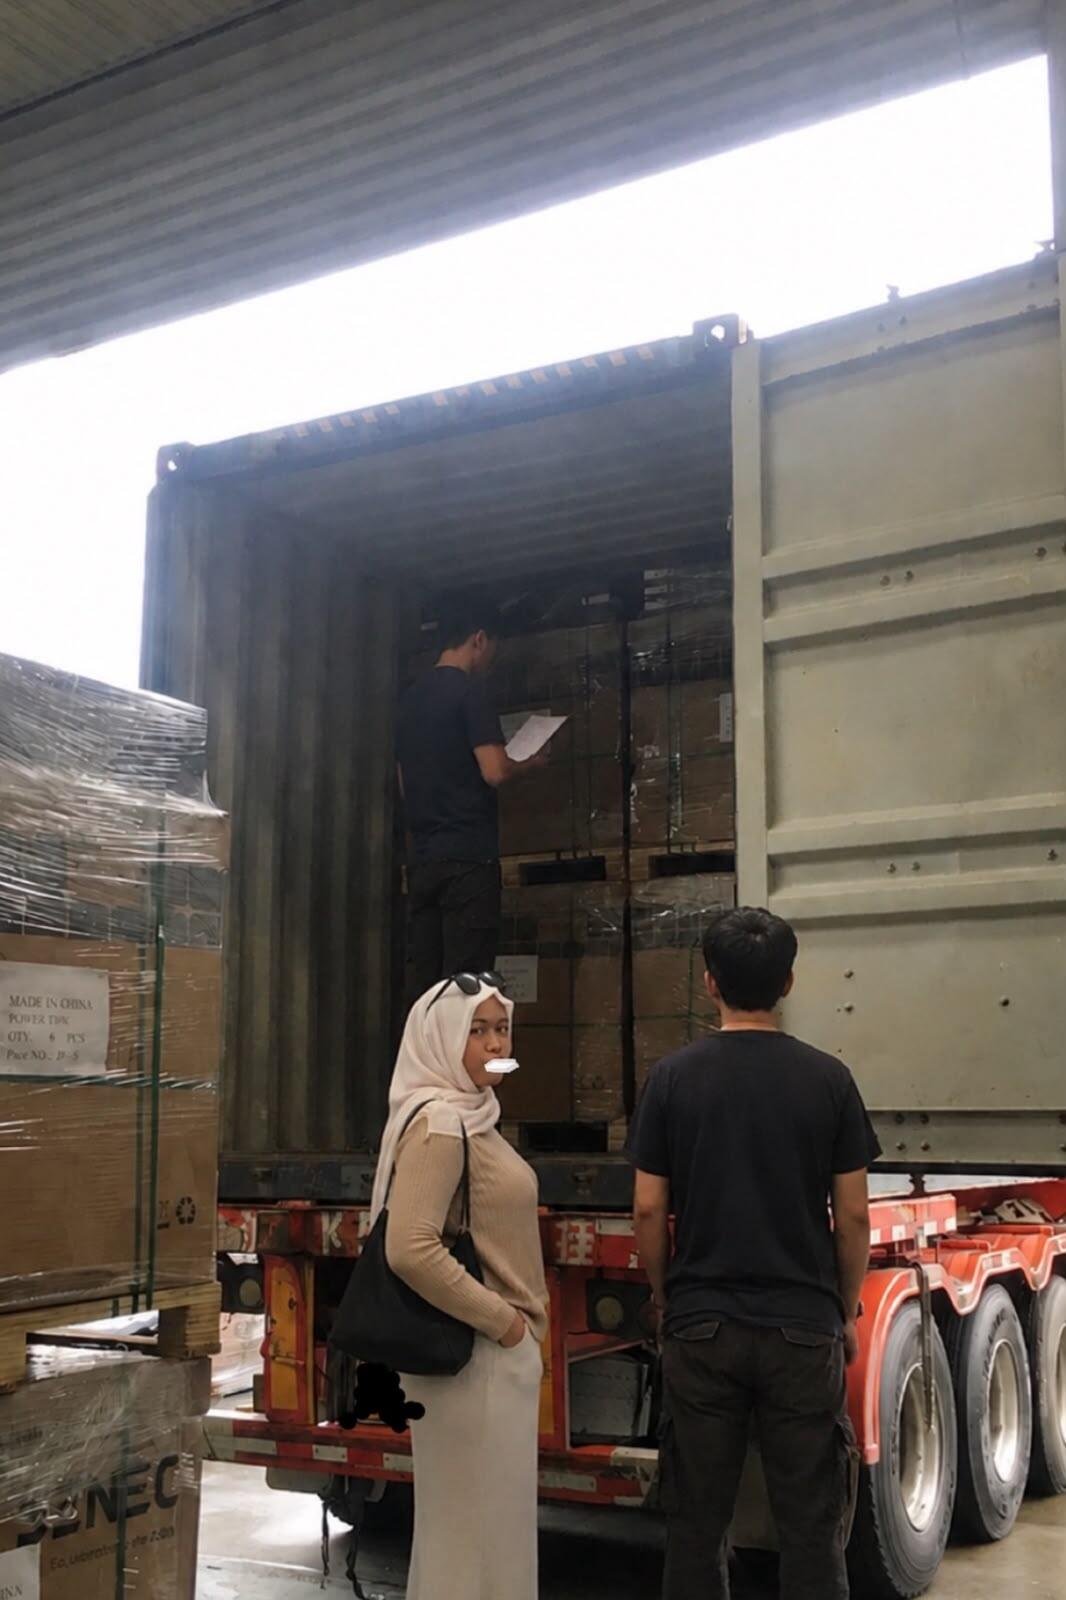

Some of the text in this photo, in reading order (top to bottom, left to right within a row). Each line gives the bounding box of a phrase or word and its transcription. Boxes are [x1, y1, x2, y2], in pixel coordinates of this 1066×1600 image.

[9, 994, 94, 1010] MADE IN CHINA
